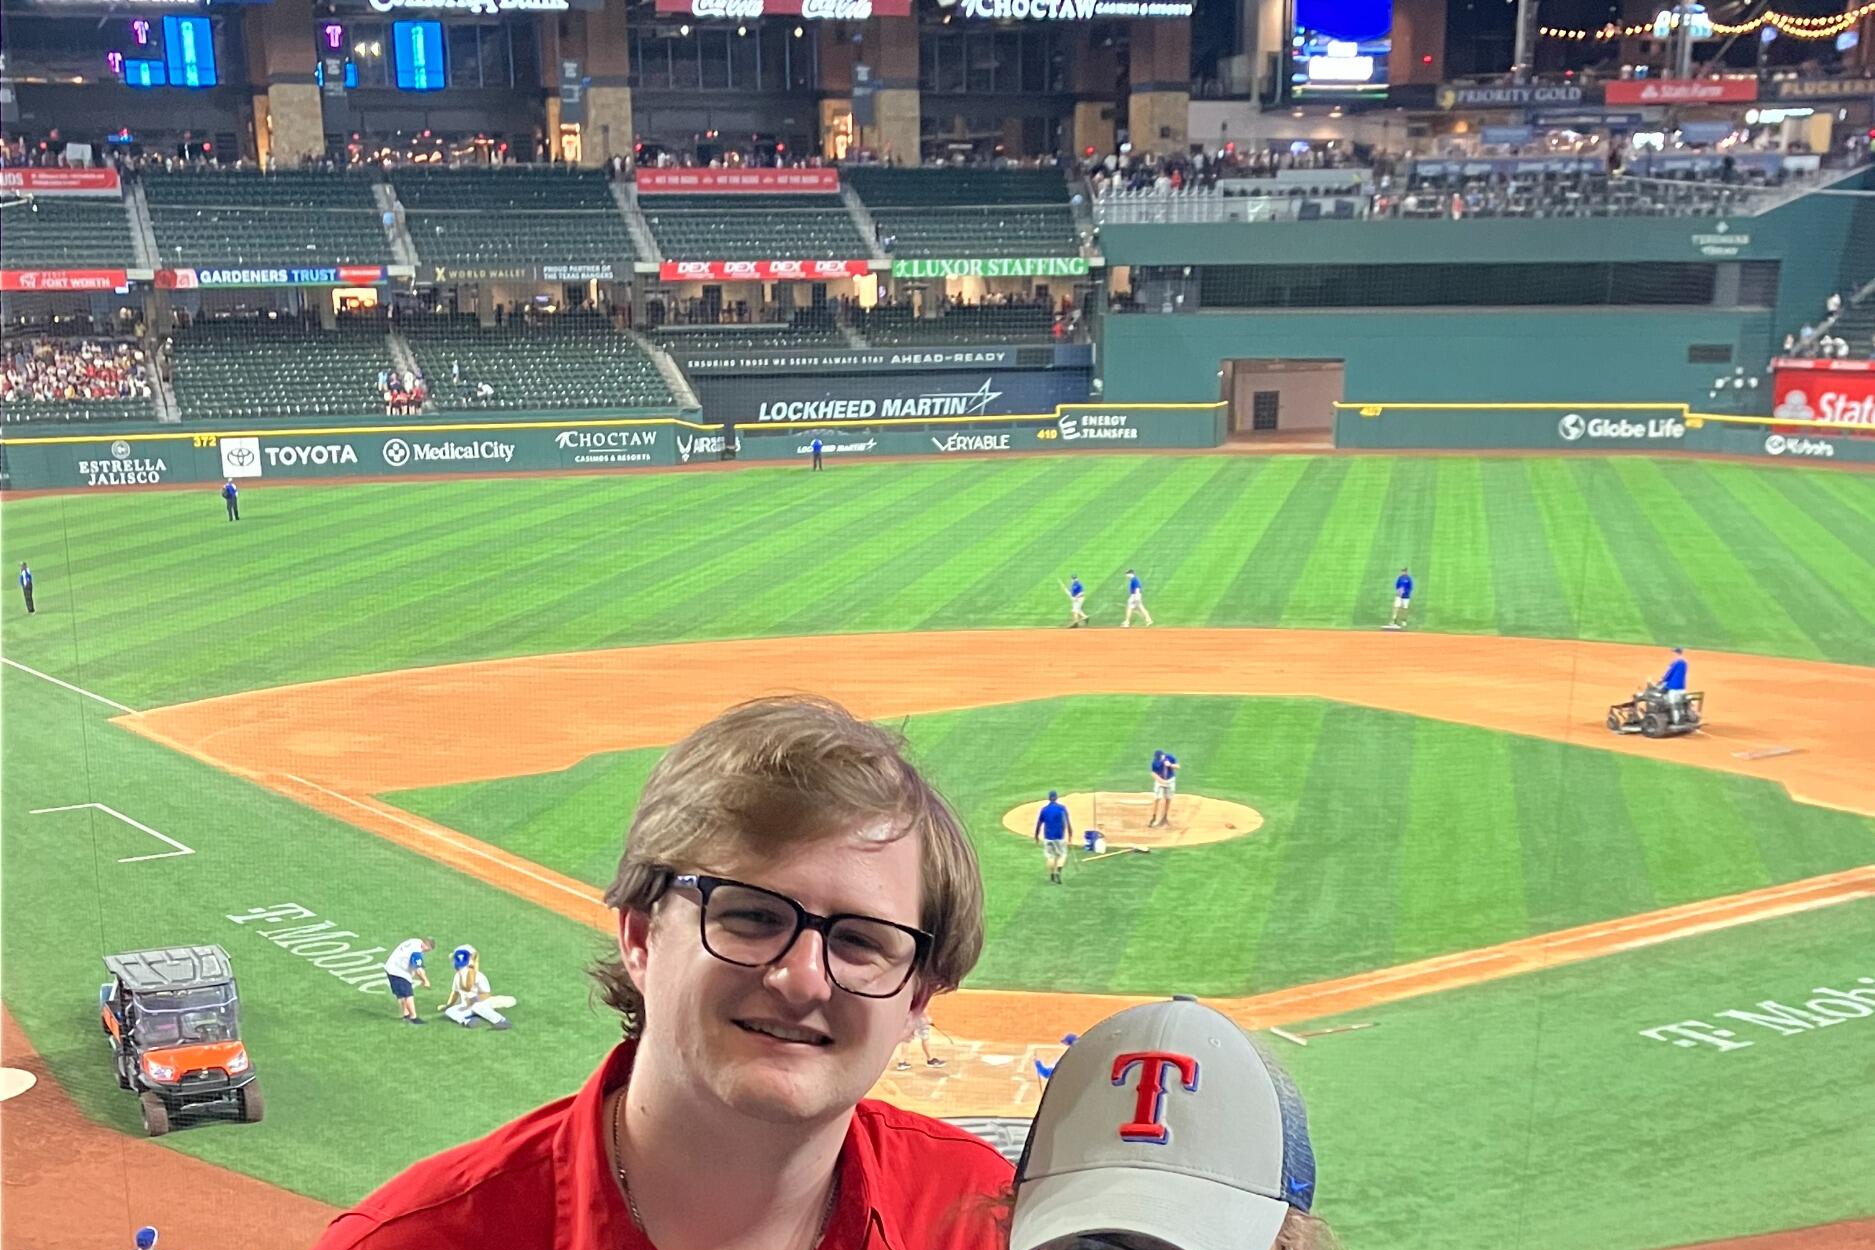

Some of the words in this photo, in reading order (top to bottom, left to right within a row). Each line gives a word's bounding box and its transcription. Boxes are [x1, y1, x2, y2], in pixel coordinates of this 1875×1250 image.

[1534, 87, 1582, 100] GOLD
[678, 262, 711, 274] DEX
[724, 262, 757, 273] DEX
[769, 261, 802, 273] DEX
[814, 260, 847, 272] DEX
[911, 259, 983, 277] LUXOR
[988, 257, 1085, 276] STAFFING
[200, 269, 288, 283] GARDENERS
[291, 269, 336, 282] TRUST
[449, 268, 485, 279] WORLD
[489, 267, 526, 278] WALLET
[71, 277, 110, 288] WORTH
[822, 356, 858, 365] ALWAYS
[891, 352, 1006, 364] AHEAD-READY
[759, 400, 876, 422] LOCKHEED
[881, 397, 968, 417] MARTIN
[1082, 416, 1127, 426] ENERGY
[1082, 428, 1138, 439] TRANSFER
[1587, 418, 1646, 438] Globe
[1649, 418, 1685, 438] Life
[193, 435, 217, 447] 372
[565, 431, 657, 448] CHOCTAW
[265, 445, 358, 466] TOYOTA
[413, 442, 480, 461] Medical
[481, 441, 515, 462] City
[79, 458, 167, 474] ESTRELLA
[88, 471, 159, 486] JALISCO
[1111, 1051, 1201, 1145] T
